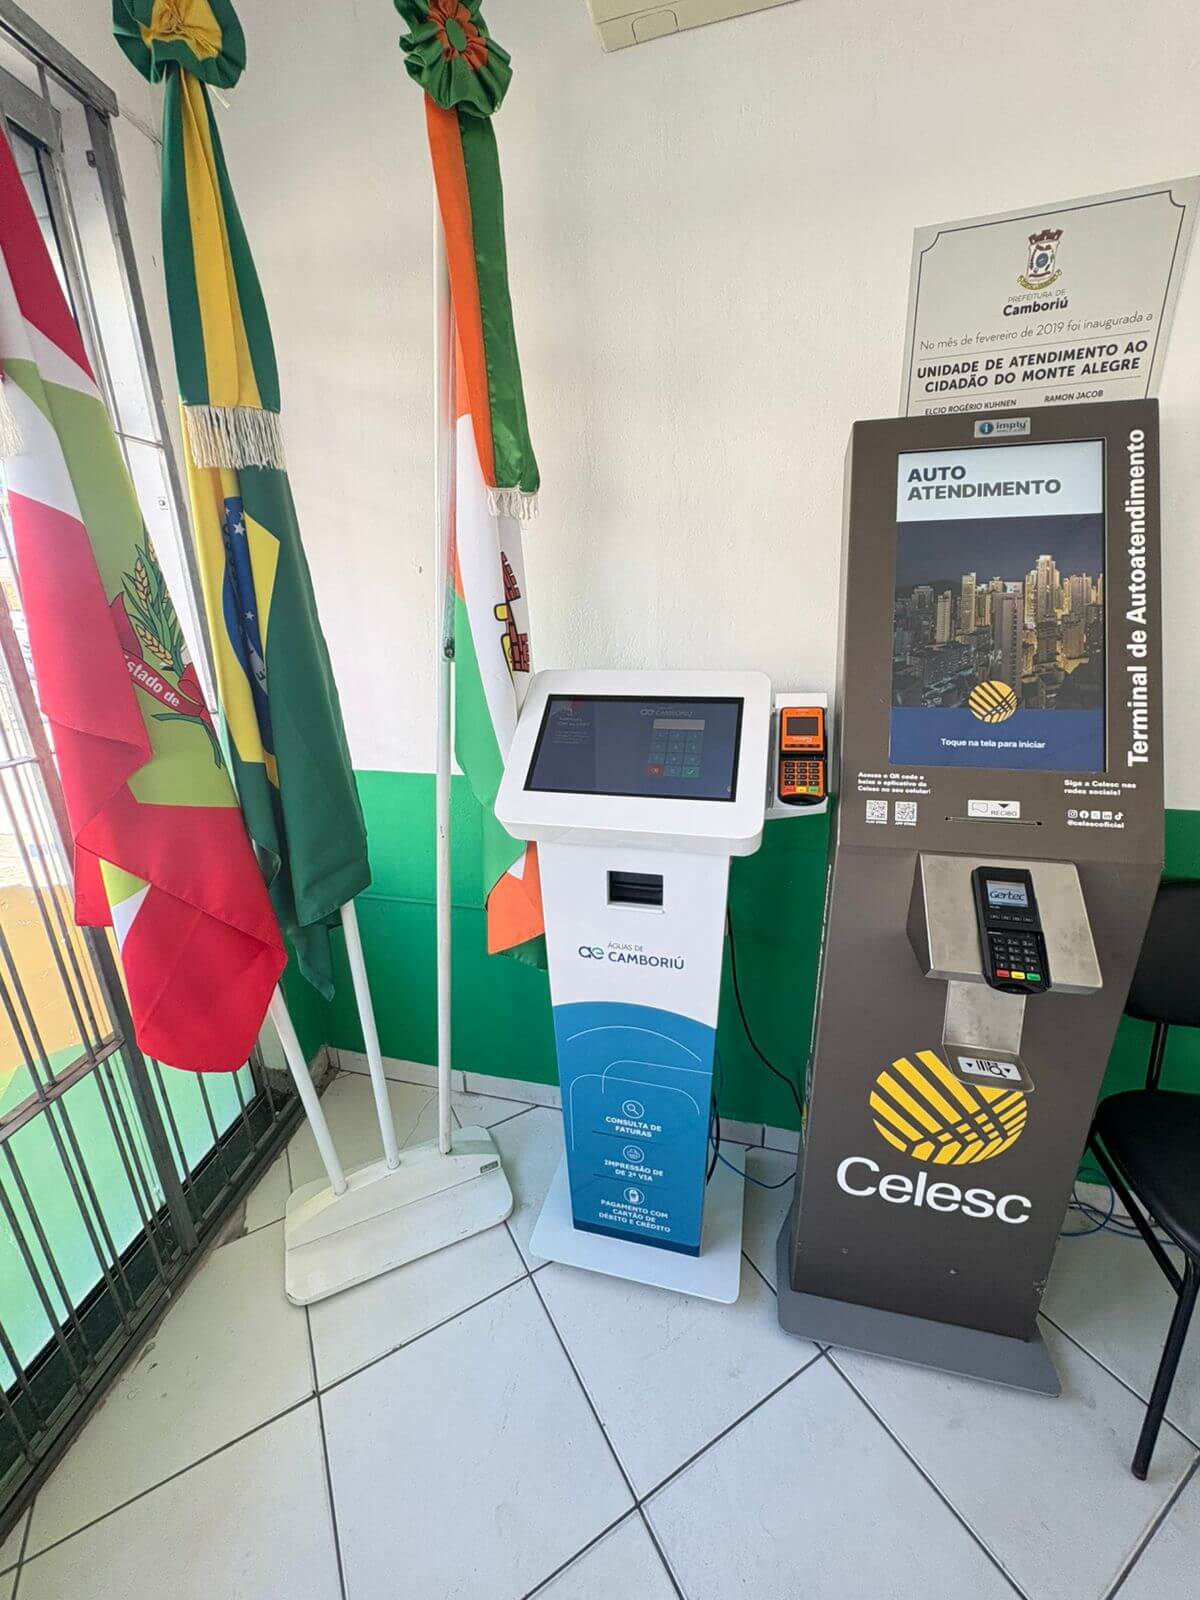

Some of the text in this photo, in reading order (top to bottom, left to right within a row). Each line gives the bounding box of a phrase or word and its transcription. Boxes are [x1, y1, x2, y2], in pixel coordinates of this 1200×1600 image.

[1008, 289, 1066, 303] PREFEITURA DE
[1003, 297, 1068, 316] Camboriú
[920, 310, 1153, 351] No mês de fevereiro de 2019 foi inaugurada a
[917, 340, 1148, 378] UNIDADE DE ATENDIMENTO AO
[925, 357, 1140, 393] CIDADÃO DO MONTE ALEGRE
[1044, 389, 1104, 402] RAMON JACOB
[925, 399, 1017, 416] ELCIO ROGÉRIO KUHNEN
[907, 465, 967, 483] AUTO
[907, 478, 1062, 501] ATENDIMENTO
[1125, 429, 1149, 767] Terminal de Autoatendimento
[123, 654, 180, 707] stado de
[940, 738, 1046, 749] Toque na tela para iniciar
[1091, 780, 1119, 788] Celesc
[990, 890, 1025, 901] Gertec
[608, 951, 684, 970] CAMBORIÚ
[605, 1116, 662, 1132] CONSULTA DE
[615, 1125, 652, 1138] FATURAS
[604, 1159, 664, 1177] IMPRESSÃO DE
[615, 1168, 626, 1176] DE
[639, 1172, 653, 1182] VIA
[836, 1156, 1032, 1224] Celesc
[600, 1199, 669, 1219] PAGAMENTO COM
[612, 1206, 656, 1223] CARTÃO DE
[598, 1211, 671, 1233] DÉBITO E CRÉDITO
